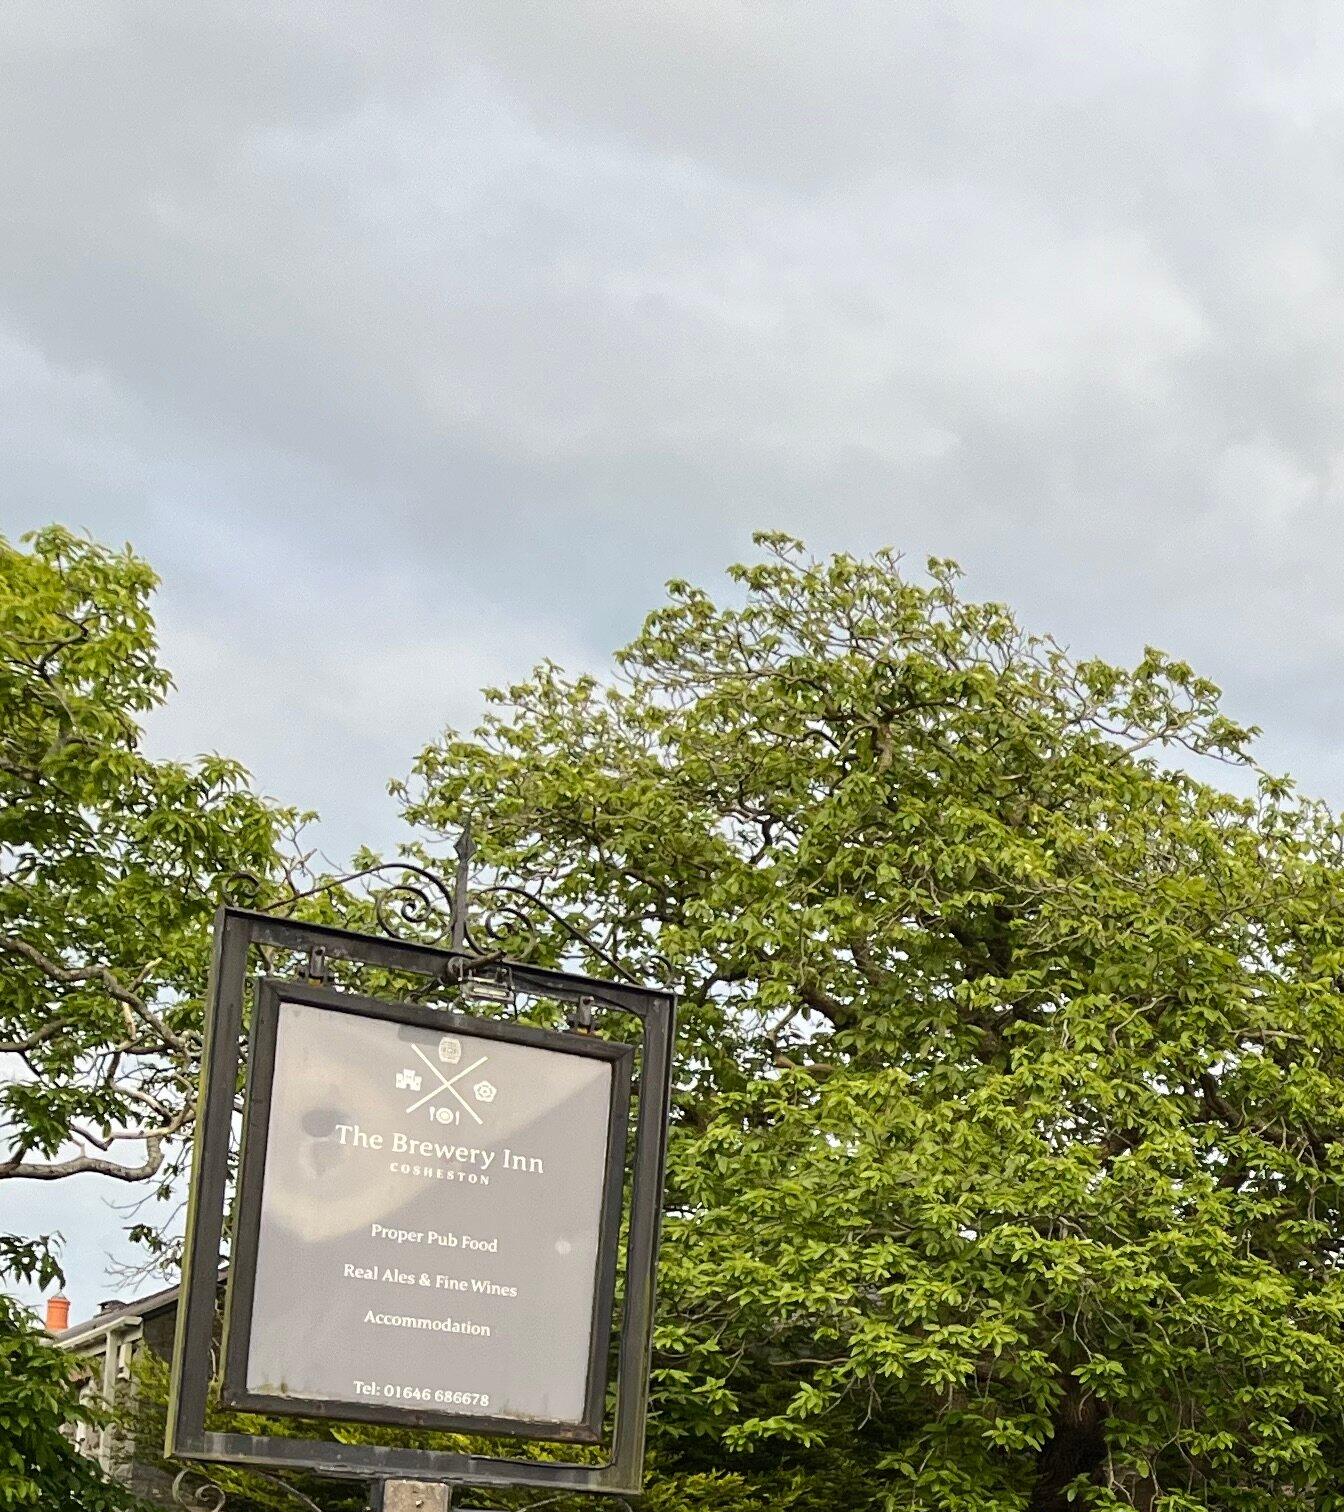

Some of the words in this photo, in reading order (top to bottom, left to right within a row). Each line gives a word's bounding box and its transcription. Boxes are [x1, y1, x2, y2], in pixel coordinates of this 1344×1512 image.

[335, 1124, 384, 1150] The
[391, 1132, 496, 1170] Brewery
[502, 1149, 545, 1174] Inn
[389, 1162, 490, 1186] COSHESTON
[371, 1223, 424, 1244] Proper
[427, 1231, 458, 1248] Pub
[461, 1235, 498, 1253] Food
[343, 1263, 378, 1281] Real
[381, 1268, 416, 1285] Ales
[418, 1272, 431, 1287] &
[435, 1274, 469, 1292] Fine
[470, 1279, 518, 1298] Wines
[363, 1309, 491, 1337] Accommodation
[353, 1380, 381, 1396] Tel:
[383, 1384, 431, 1401] 01646
[434, 1389, 490, 1407] 686678
